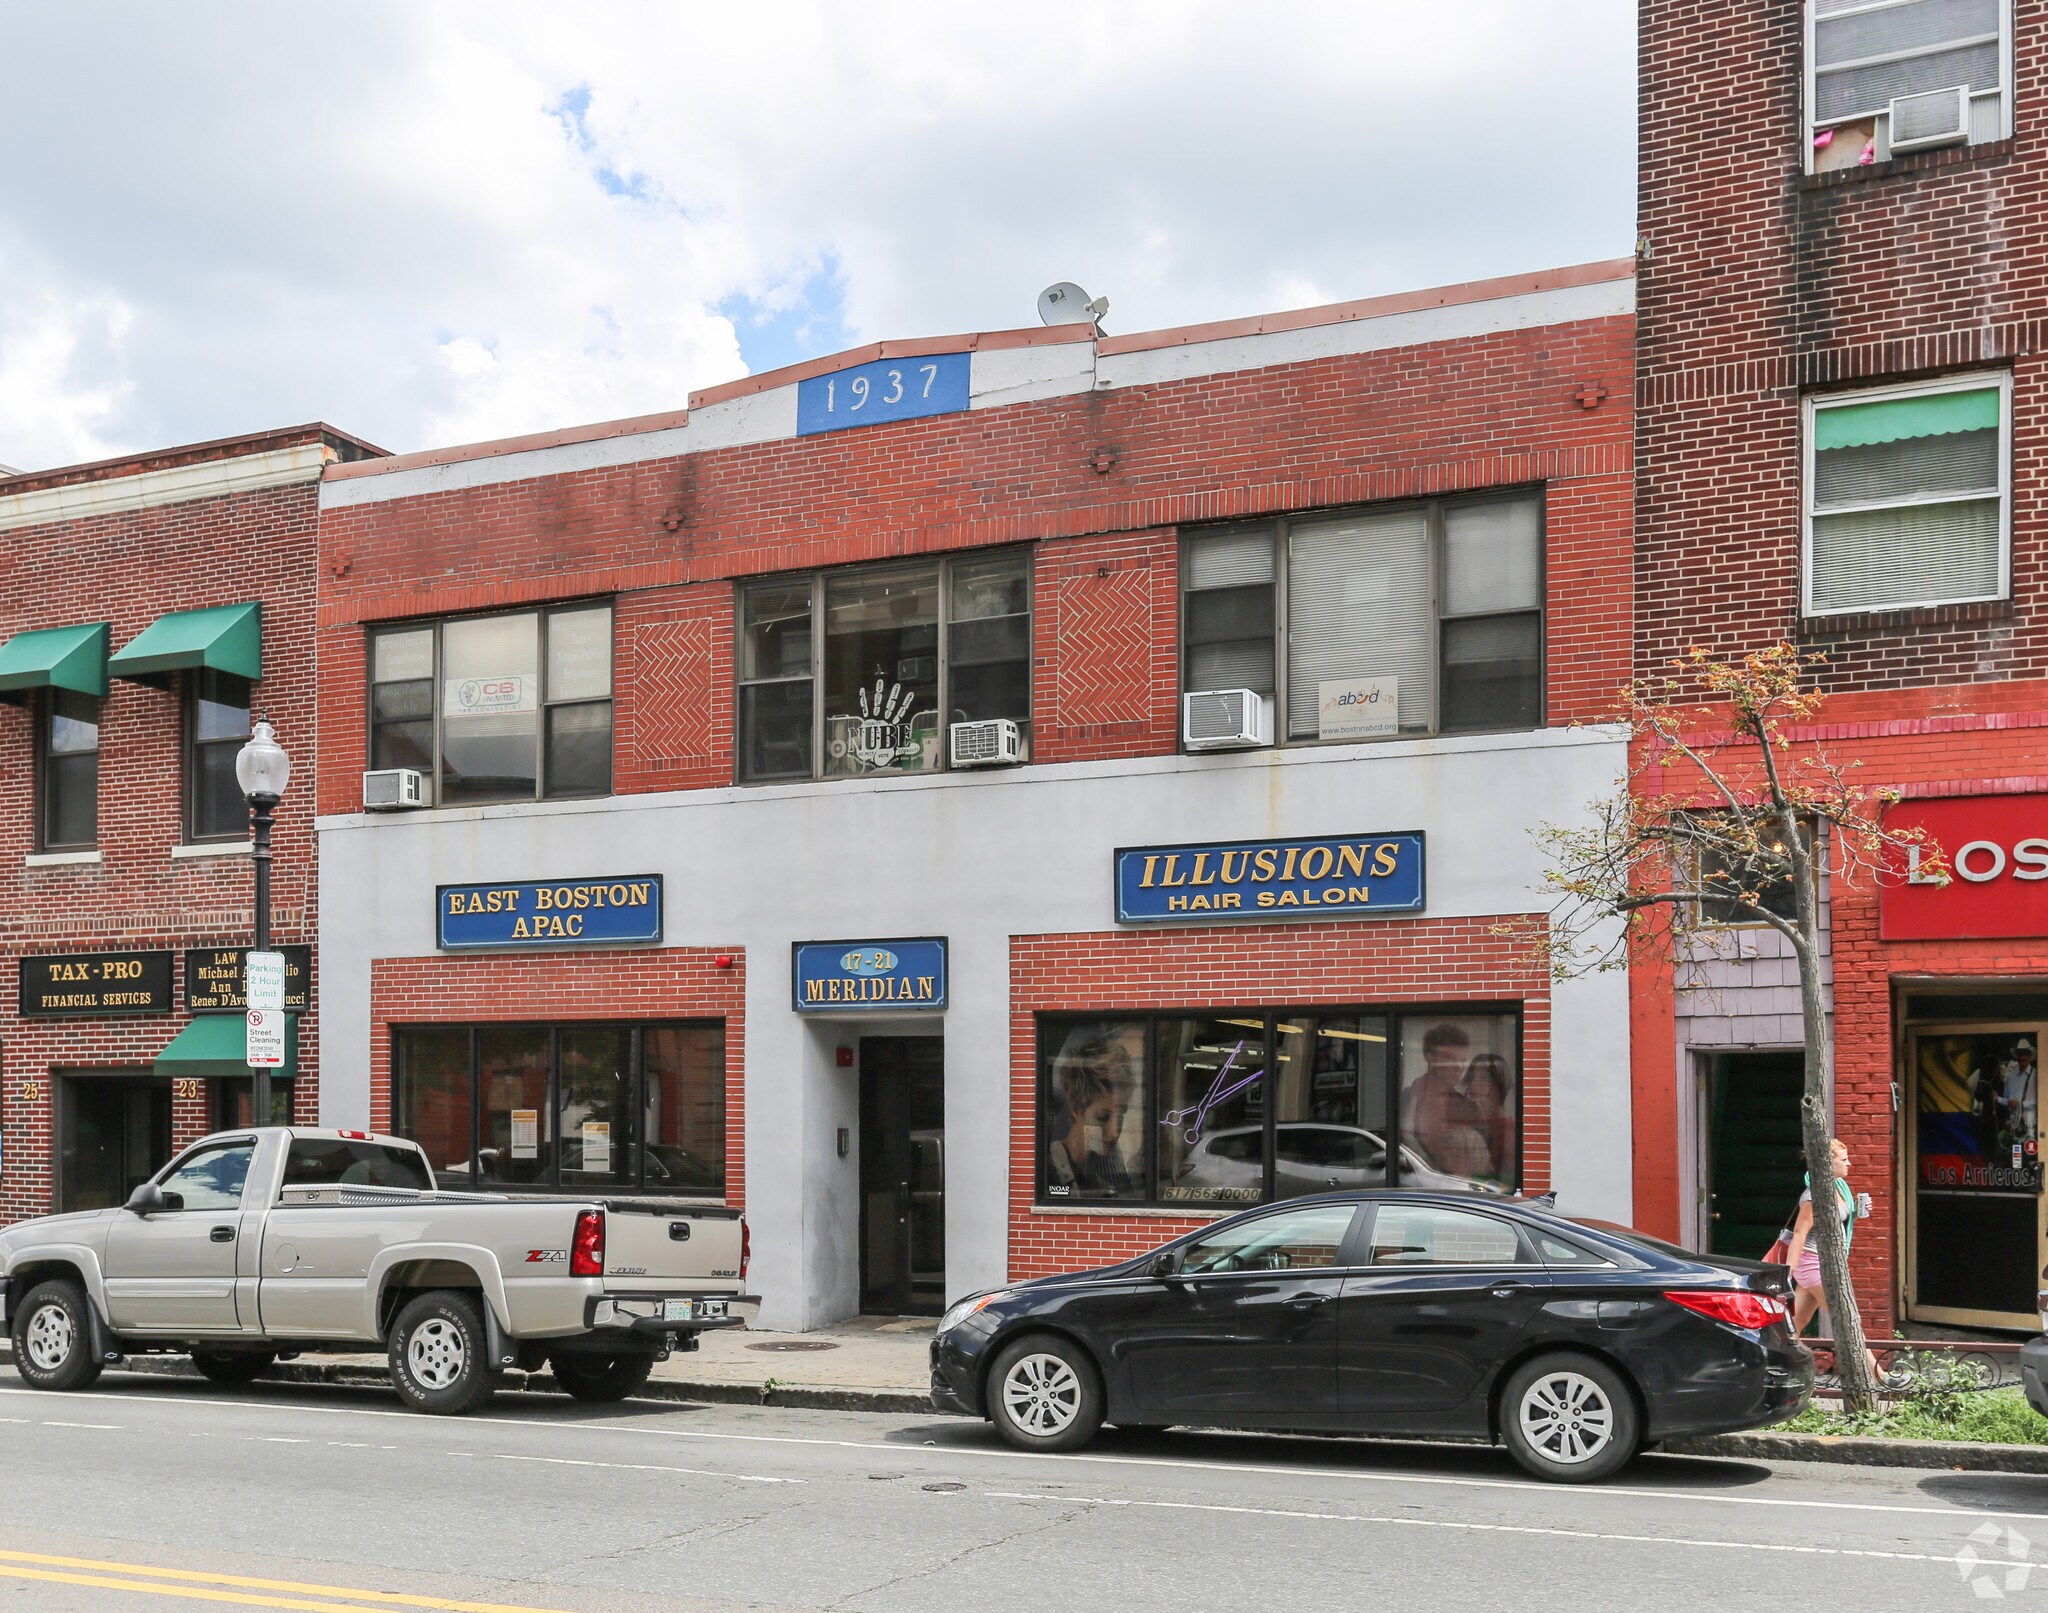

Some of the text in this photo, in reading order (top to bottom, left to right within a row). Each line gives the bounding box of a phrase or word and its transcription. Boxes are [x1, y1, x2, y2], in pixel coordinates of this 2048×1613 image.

[827, 364, 938, 413] 1937
[483, 682, 515, 695] CB
[483, 694, 514, 702] UNLIMITED
[1338, 689, 1380, 706] abcd
[1321, 723, 1397, 735] www.bostonabcd.org
[848, 723, 913, 753] NUBE
[1138, 843, 1400, 888] ILLUSIONS
[1909, 838, 2048, 885] LOS
[449, 883, 650, 915] EAST BOSTON
[1168, 886, 1369, 911] HAIR SALON
[512, 914, 583, 938] APAC
[214, 952, 238, 965] LAW
[198, 966, 238, 980] Michael
[249, 963, 283, 975] Parking
[209, 981, 232, 993] Ann
[250, 976, 281, 986] 2 Hour
[254, 990, 277, 998] Limit
[805, 976, 935, 1002] MERIDIAN
[41, 992, 152, 1007] FINANCIAL SERVICES
[191, 995, 218, 1007] Renee
[221, 993, 247, 1007] D'Avo
[249, 1028, 272, 1036] Street
[249, 1036, 281, 1045] Cleaning
[23, 1082, 38, 1100] 25
[180, 1080, 196, 1098] 23
[1928, 1162, 2035, 1187] Los Arrieros
[1193, 1187, 1220, 1199] 569
[1224, 1188, 1259, 1200] 0000
[525, 1249, 566, 1262] Z71
